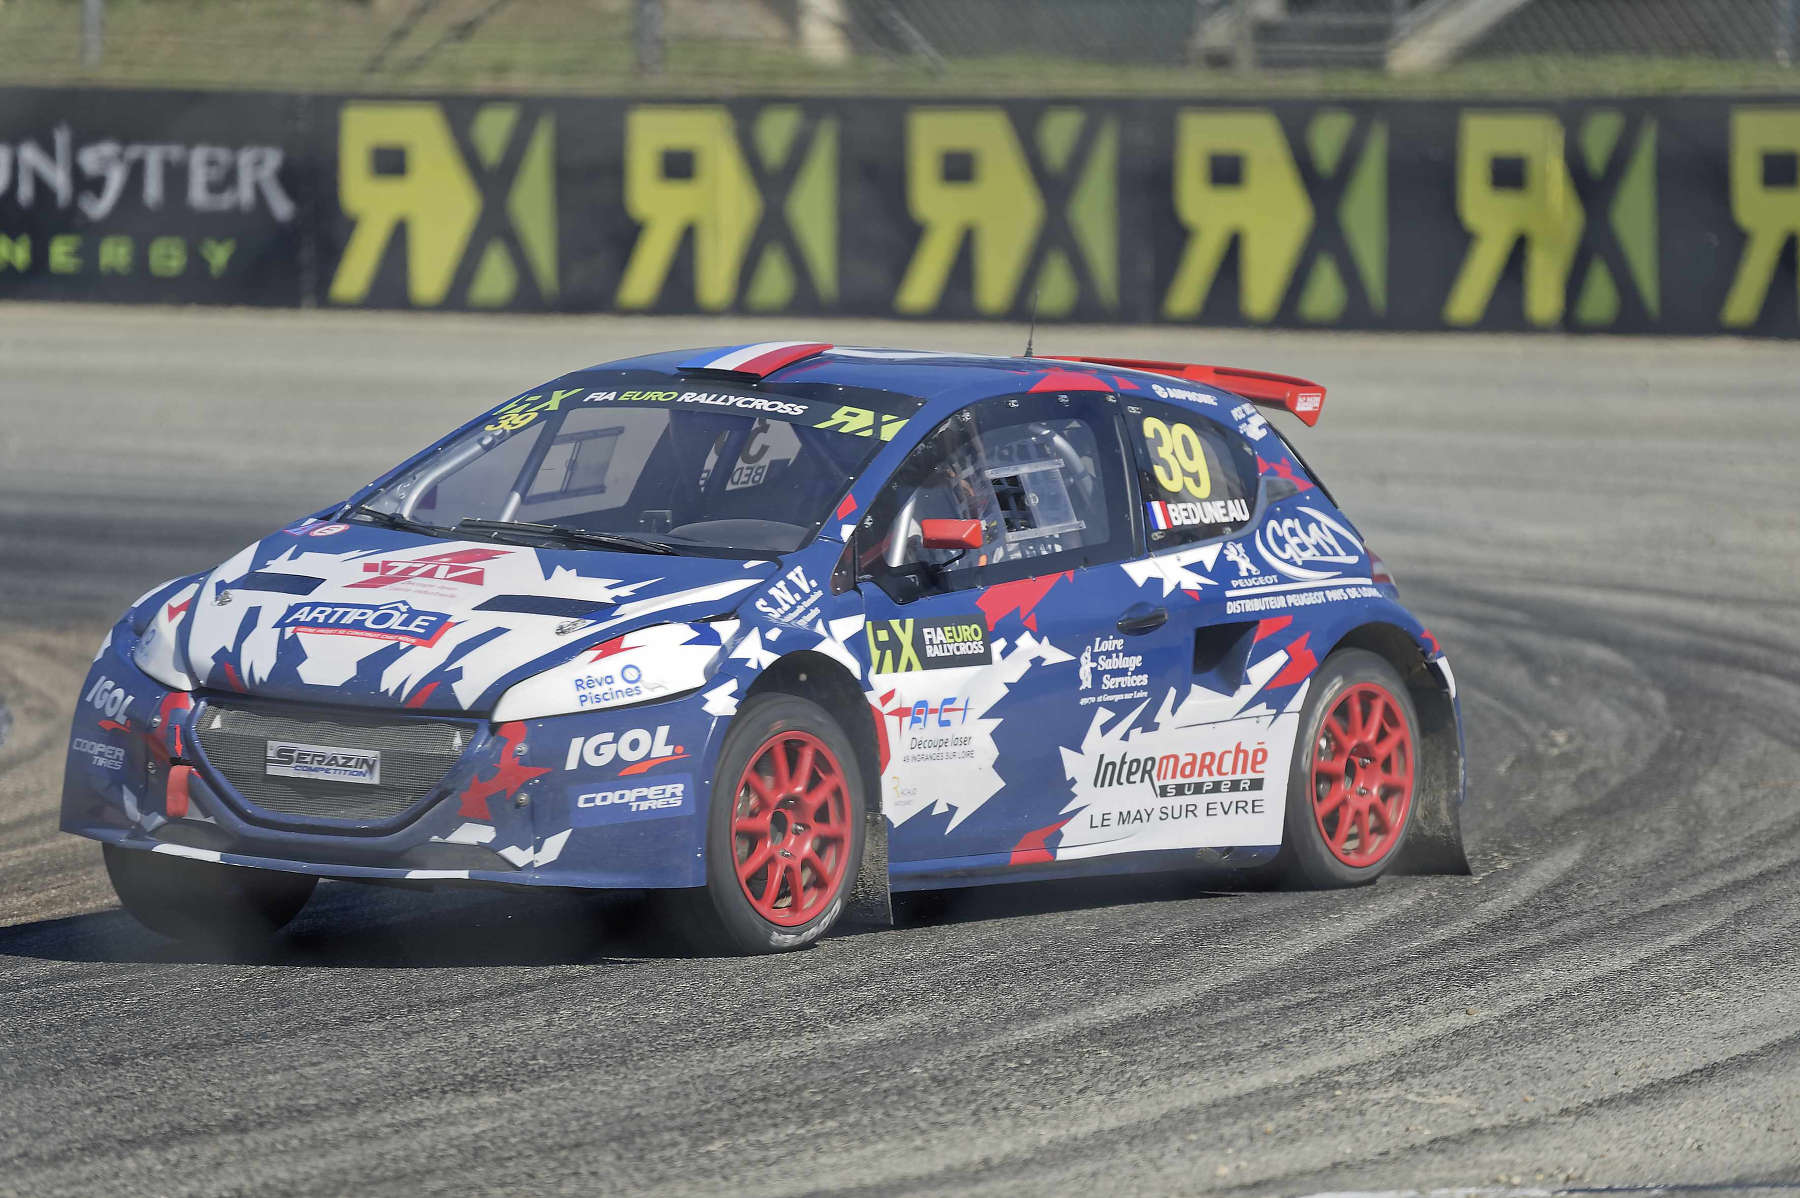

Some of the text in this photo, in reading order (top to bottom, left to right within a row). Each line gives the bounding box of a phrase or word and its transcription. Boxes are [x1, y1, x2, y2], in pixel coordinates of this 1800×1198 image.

[583, 390, 809, 416] FIA EURO RALLYCROSS
[484, 411, 539, 431] 39
[1143, 416, 1211, 499] 39
[1166, 498, 1250, 526] BEDUNEAU
[755, 565, 818, 619] S.N.V.
[1230, 575, 1278, 588] PEUGEOT
[1226, 596, 1286, 614] DISTRIBUTEUR
[1286, 591, 1326, 607] PEUGEOT
[285, 602, 438, 633] ARTIPÔLE
[925, 641, 985, 658] RALLYCROSS
[1093, 635, 1124, 652] Loire
[1097, 653, 1142, 671] Sablage
[574, 675, 614, 691] Rêva
[1102, 671, 1148, 689] Services
[86, 675, 135, 725] IGOL
[580, 685, 643, 706] Piscines
[73, 738, 125, 760] COOPER
[92, 756, 123, 770] TIRES
[268, 745, 377, 778] SERAZIN
[293, 765, 368, 777] COMPETITION
[577, 783, 685, 808] COOPER
[628, 797, 682, 812] TIRES
[1089, 799, 1265, 829] LE MAY SUR EVRE
